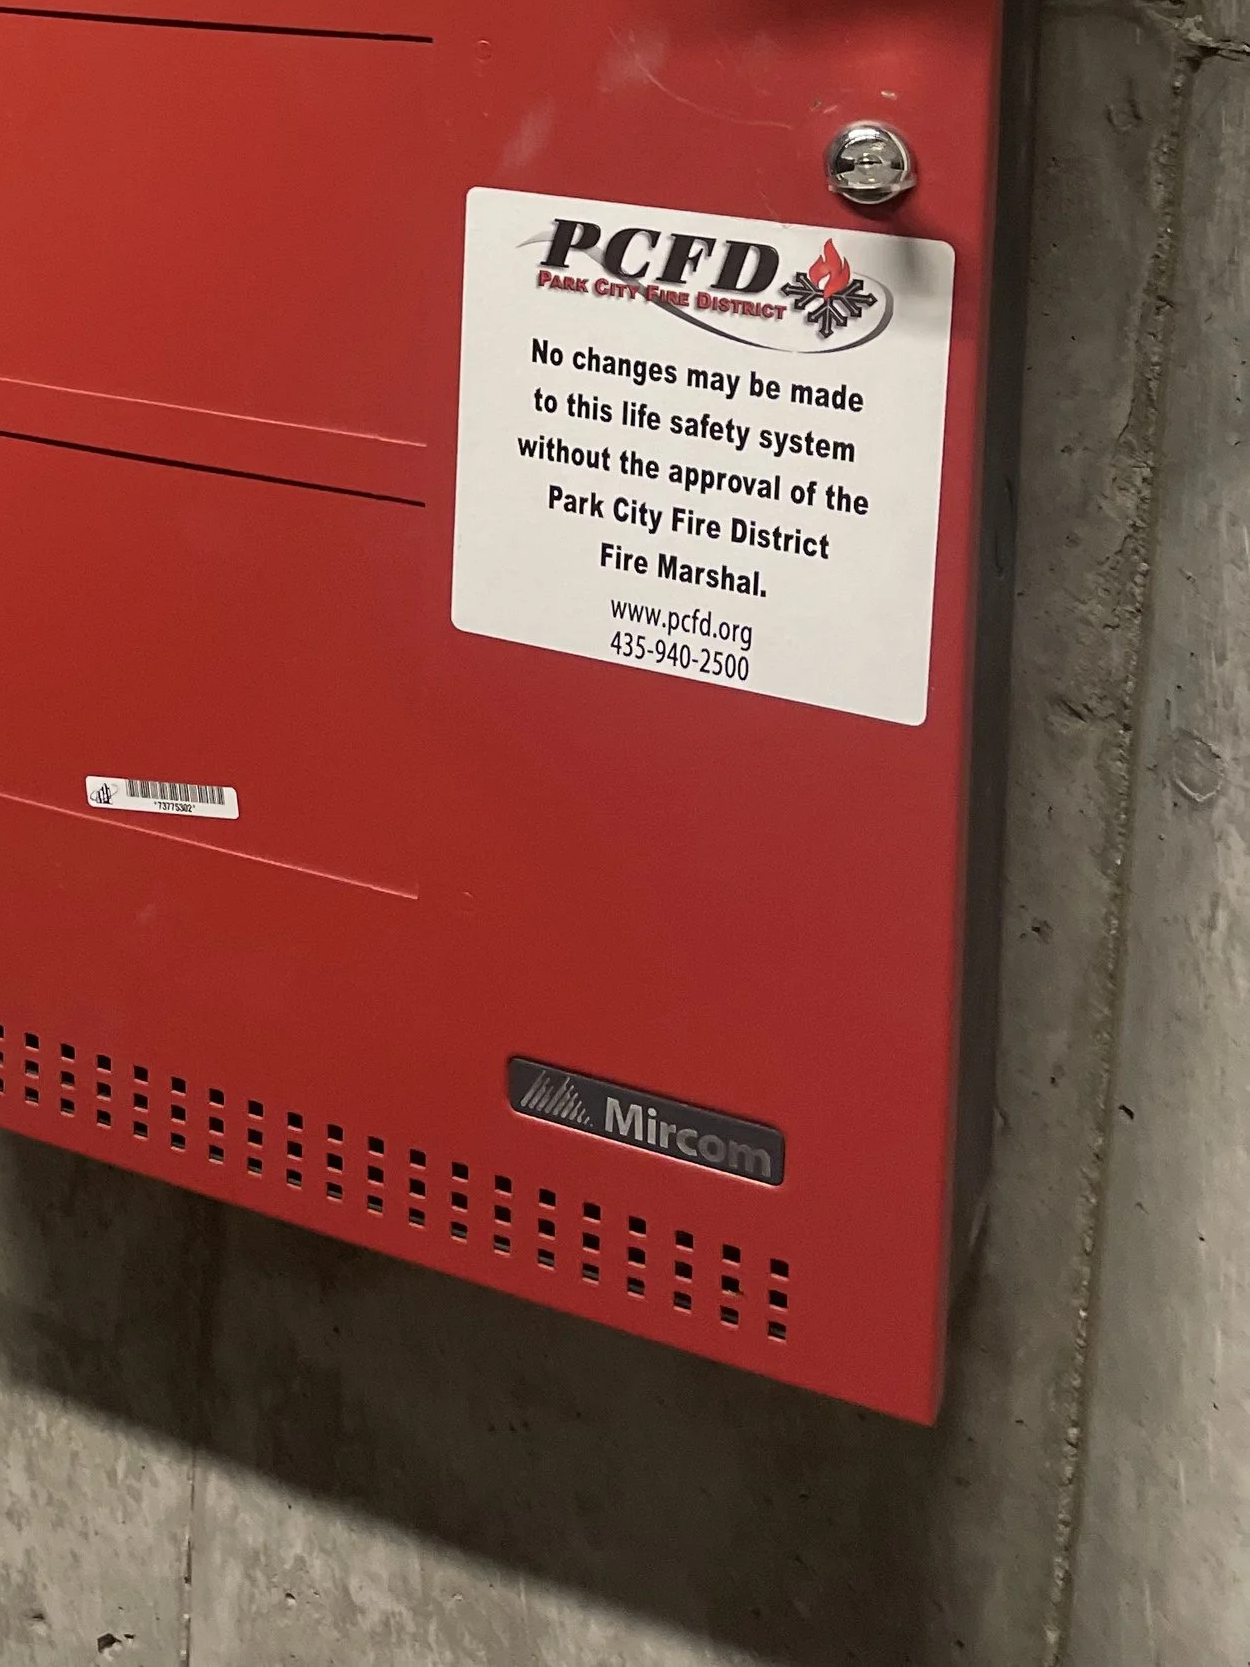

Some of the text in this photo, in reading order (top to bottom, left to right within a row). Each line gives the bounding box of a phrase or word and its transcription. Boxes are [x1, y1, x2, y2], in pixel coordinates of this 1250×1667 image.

[540, 218, 781, 295] PCFD
[536, 269, 789, 321] PARK CITY FIRE DISTRICT
[530, 338, 864, 414] No changes may be made
[533, 387, 855, 463] to this life safety system
[517, 434, 870, 516] without the approval of the
[547, 484, 830, 560] Park City Fire District
[599, 541, 768, 598] Fire Marshal.
[609, 630, 751, 682] 435-940-2500
[610, 598, 754, 651] www.pcfd.org
[605, 1096, 772, 1179] Mircom
